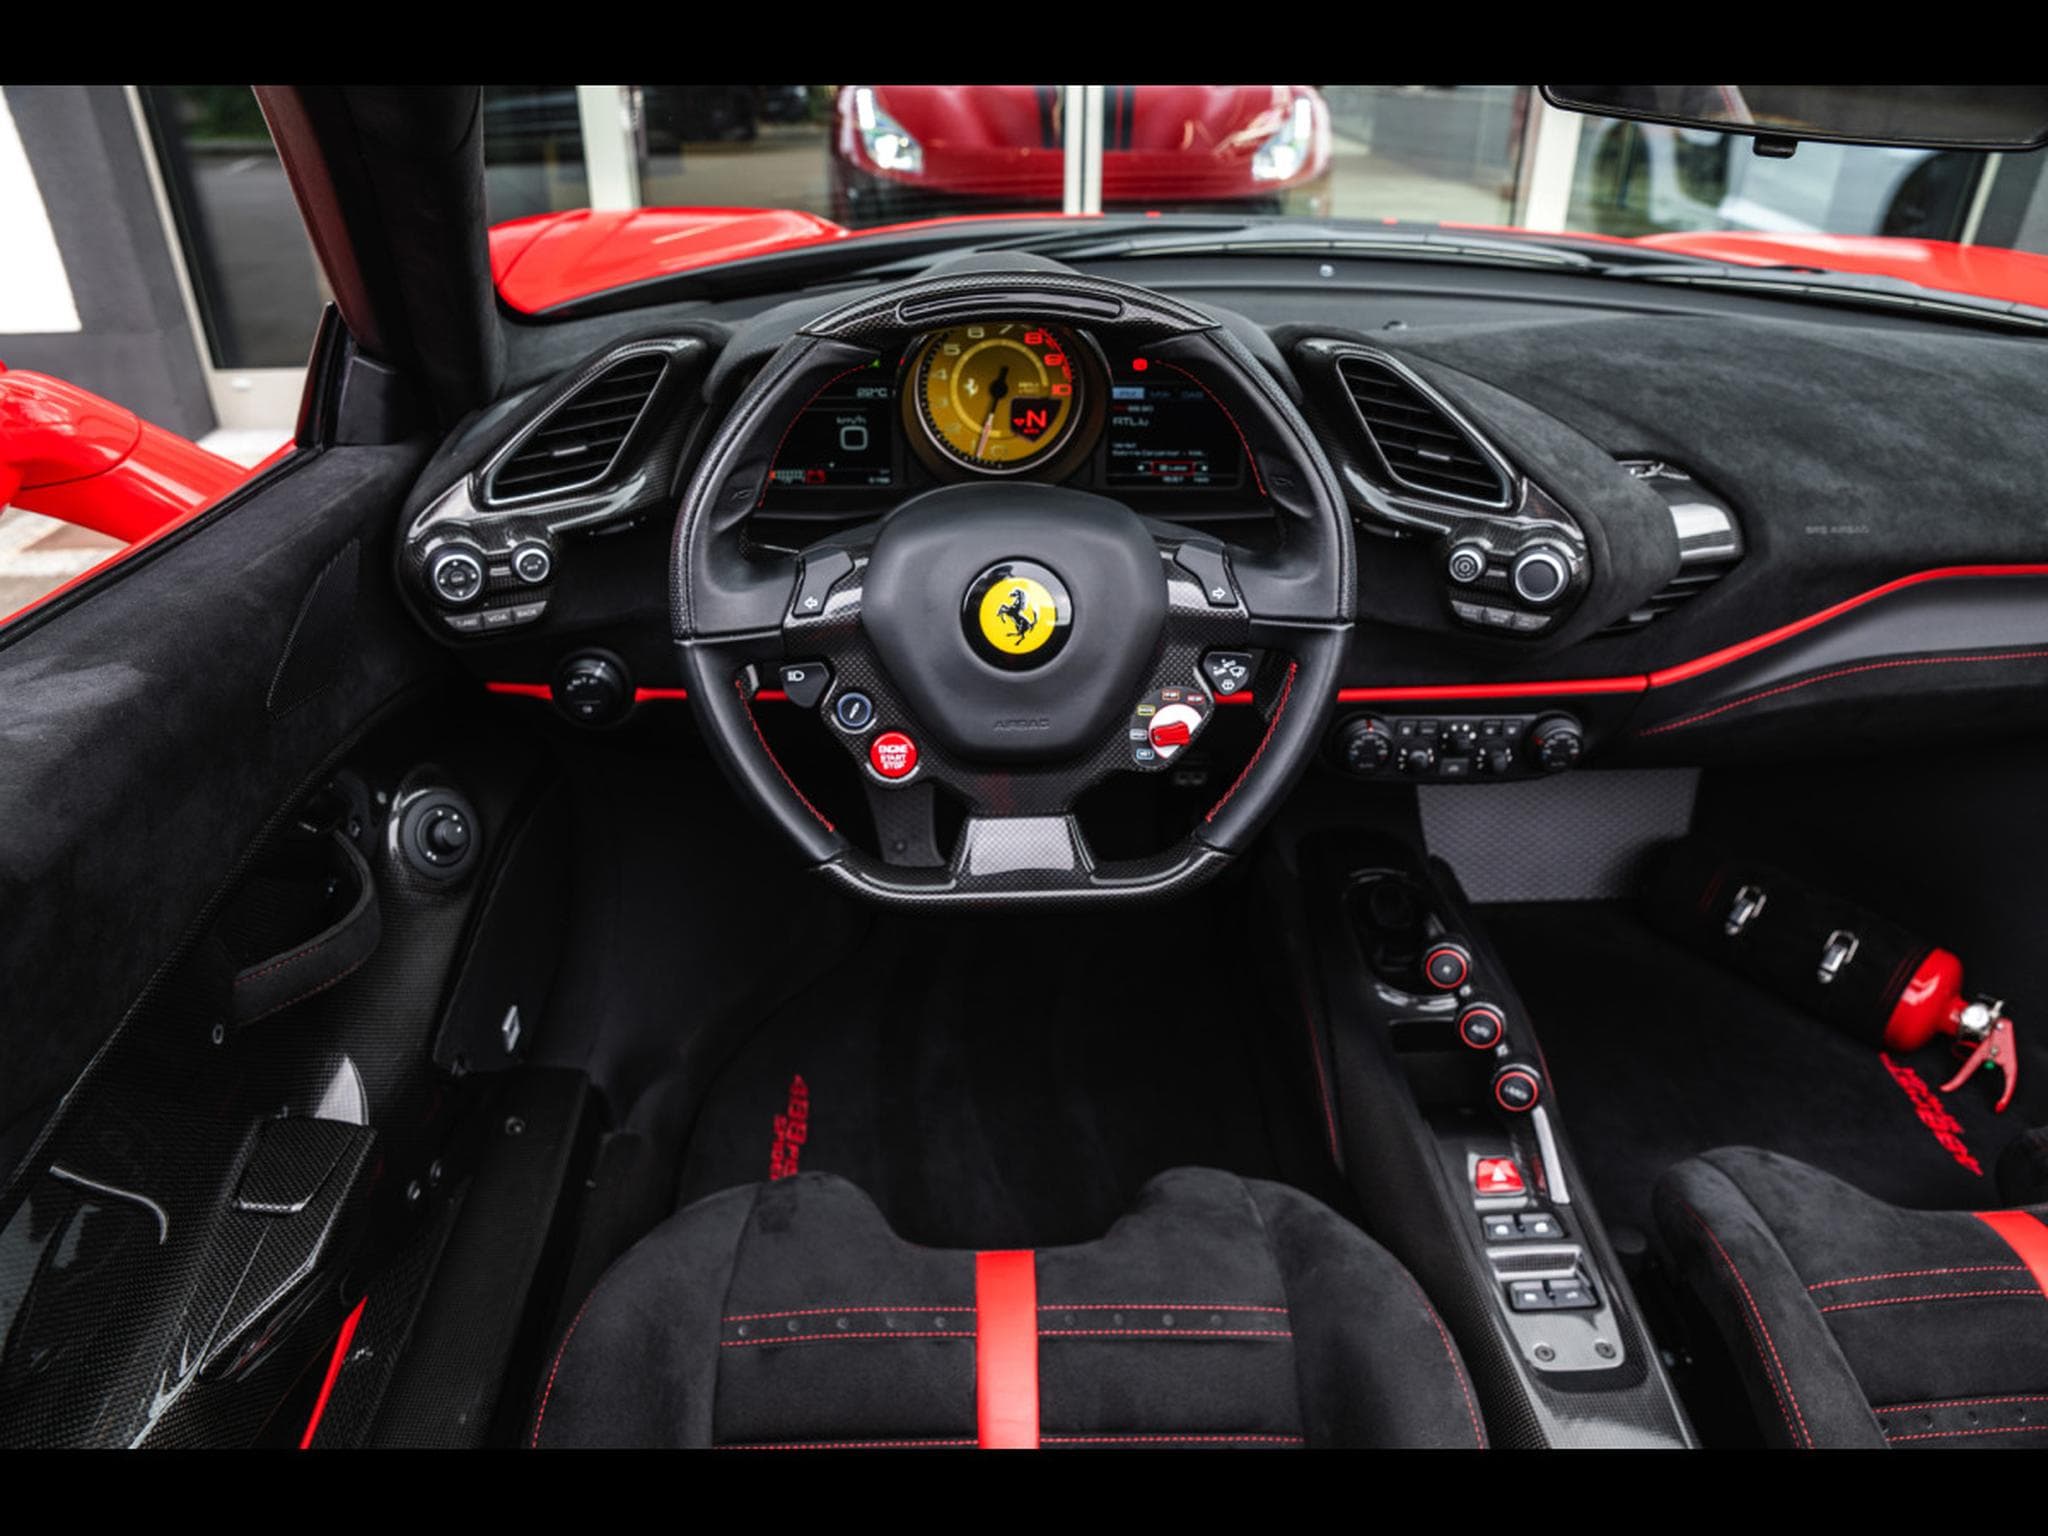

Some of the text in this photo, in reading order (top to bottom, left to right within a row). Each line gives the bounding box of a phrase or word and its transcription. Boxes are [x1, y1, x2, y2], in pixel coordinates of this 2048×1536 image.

[967, 326, 985, 339] 6
[1024, 331, 1043, 345] 8
[943, 344, 961, 356] 5
[1052, 384, 1072, 396] 10
[1025, 409, 1048, 428] N
[840, 426, 868, 451] 0
[878, 744, 908, 754] ENGINE
[880, 754, 906, 763] START
[883, 761, 905, 770] STOP
